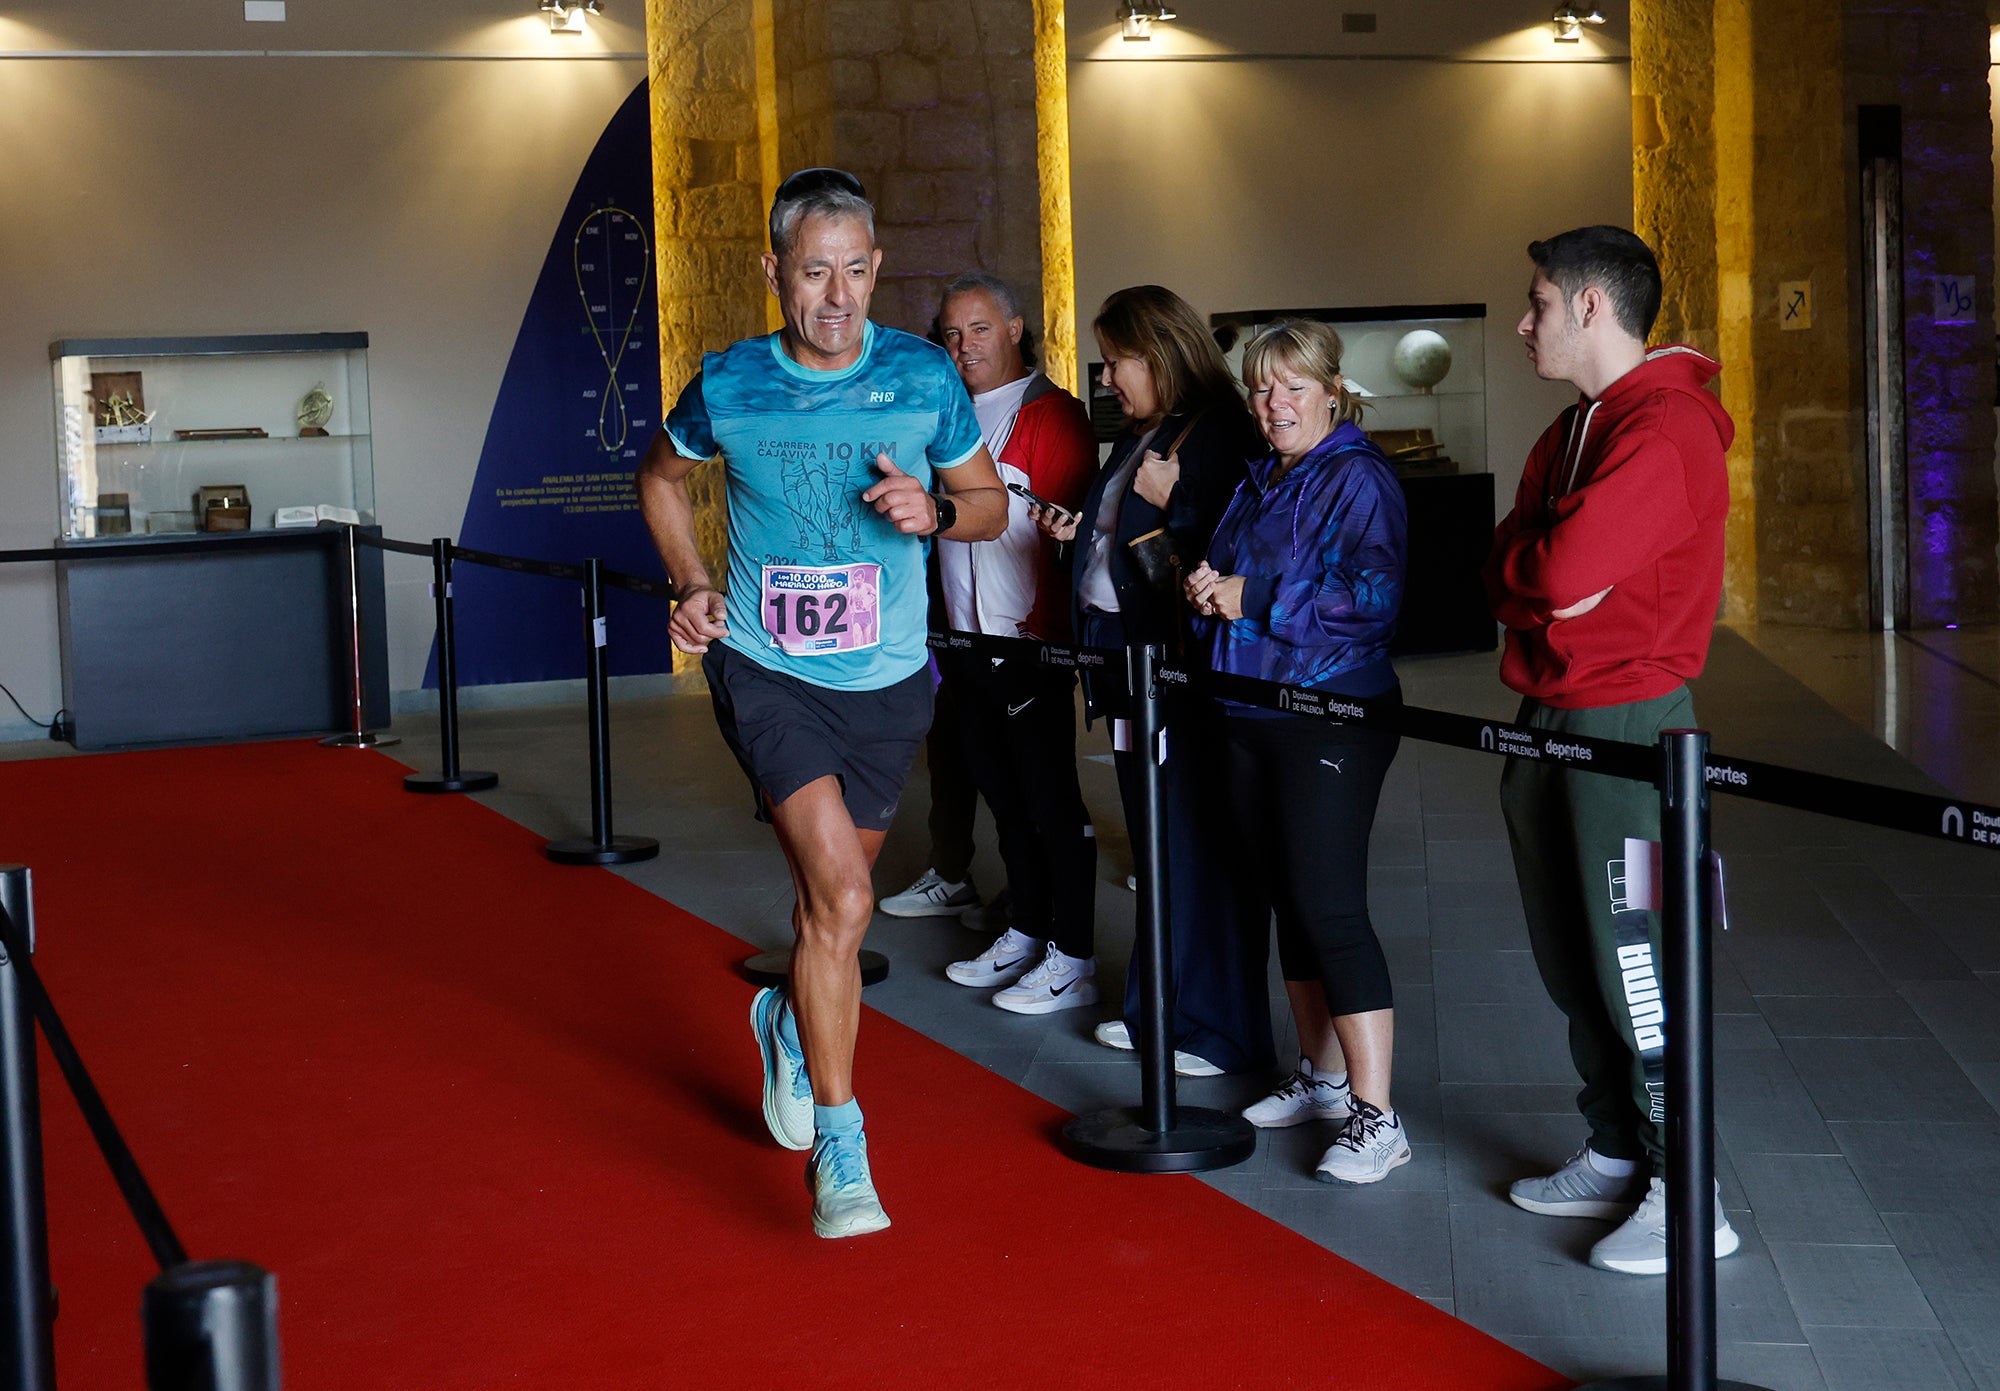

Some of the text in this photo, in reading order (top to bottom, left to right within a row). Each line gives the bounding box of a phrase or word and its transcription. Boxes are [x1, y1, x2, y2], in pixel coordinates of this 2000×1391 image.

[582, 264, 594, 272] FEB
[583, 390, 596, 398] AGO
[585, 429, 596, 437] JUL
[770, 441, 816, 450] CARRERA
[826, 442, 896, 460] 10 KM
[757, 449, 816, 459] CAJAVIVA
[542, 475, 574, 484] ANALEMA
[575, 474, 584, 482] DE
[586, 474, 600, 482] SAN
[601, 473, 623, 481] PEDRO
[775, 581, 815, 589] MARIANO
[789, 574, 827, 583] 10.000
[770, 593, 847, 636] 162
[950, 636, 972, 648] deportes
[1078, 652, 1104, 665] deportes
[1159, 667, 1187, 683] deportes
[1292, 690, 1318, 702] Diputación
[1292, 703, 1324, 716] DE PALENCIA
[1329, 699, 1364, 718] deportes
[1499, 728, 1532, 743] Diputación
[1499, 742, 1540, 758] DE PALENCIA
[1545, 739, 1592, 761] deportes
[1704, 765, 1748, 786] portes
[1972, 829, 1987, 842] DE
[1617, 943, 1665, 1051] PUMA
